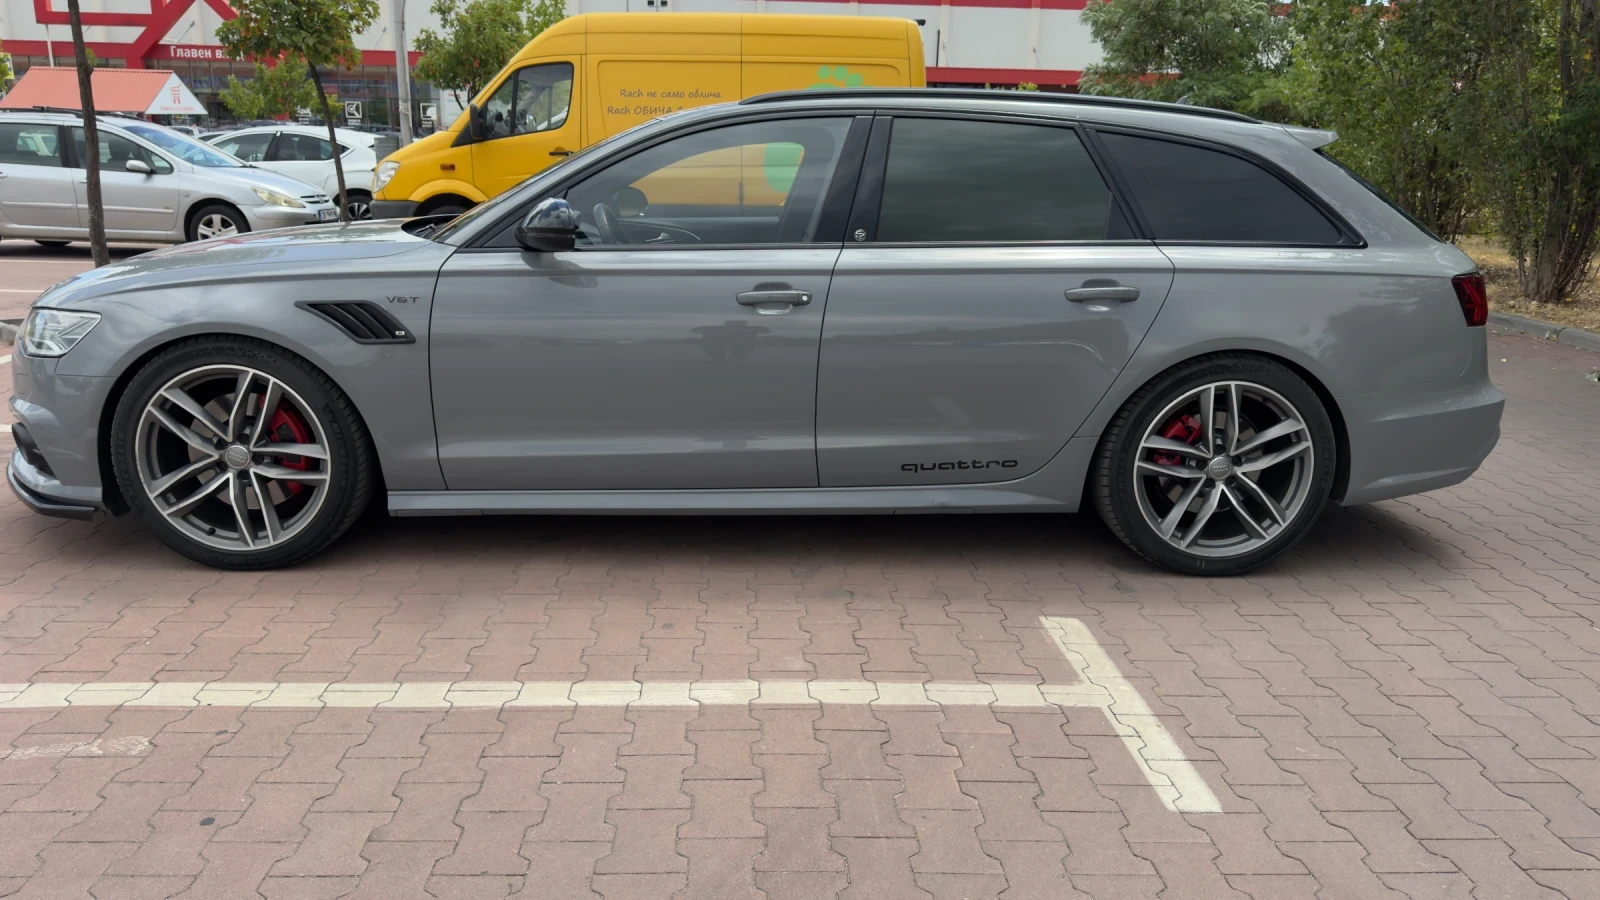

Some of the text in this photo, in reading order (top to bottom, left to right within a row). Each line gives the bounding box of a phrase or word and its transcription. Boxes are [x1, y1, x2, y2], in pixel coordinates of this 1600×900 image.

[170, 45, 212, 58] Главен
[620, 88, 643, 98] Rach
[607, 105, 631, 115] Rach
[634, 105, 673, 115] ОБИЧА
[386, 295, 420, 304] V6T
[900, 459, 1019, 474] quattro
